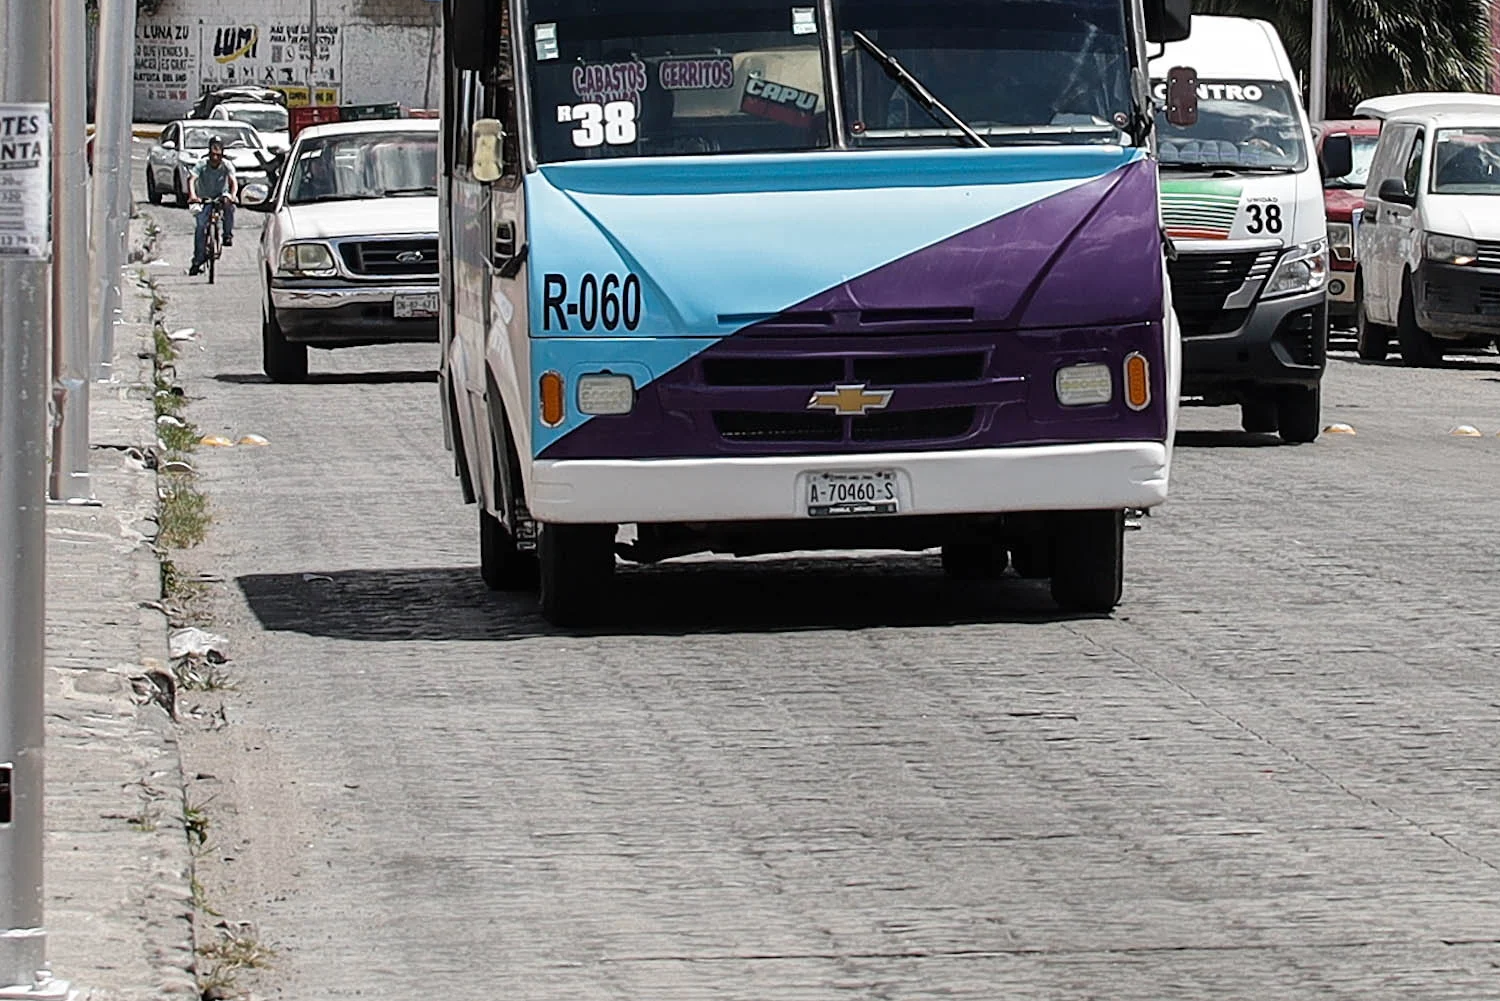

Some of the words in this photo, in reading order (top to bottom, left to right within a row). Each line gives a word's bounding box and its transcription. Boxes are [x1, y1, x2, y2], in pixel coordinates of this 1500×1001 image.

[659, 57, 733, 90] CERRITOS
[746, 79, 818, 110] CAPU
[1153, 84, 1263, 101] CNTRO
[0, 115, 39, 136] TES
[1246, 204, 1283, 234] 38
[543, 273, 640, 331] R-060
[811, 482, 894, 502] A-70460-S
